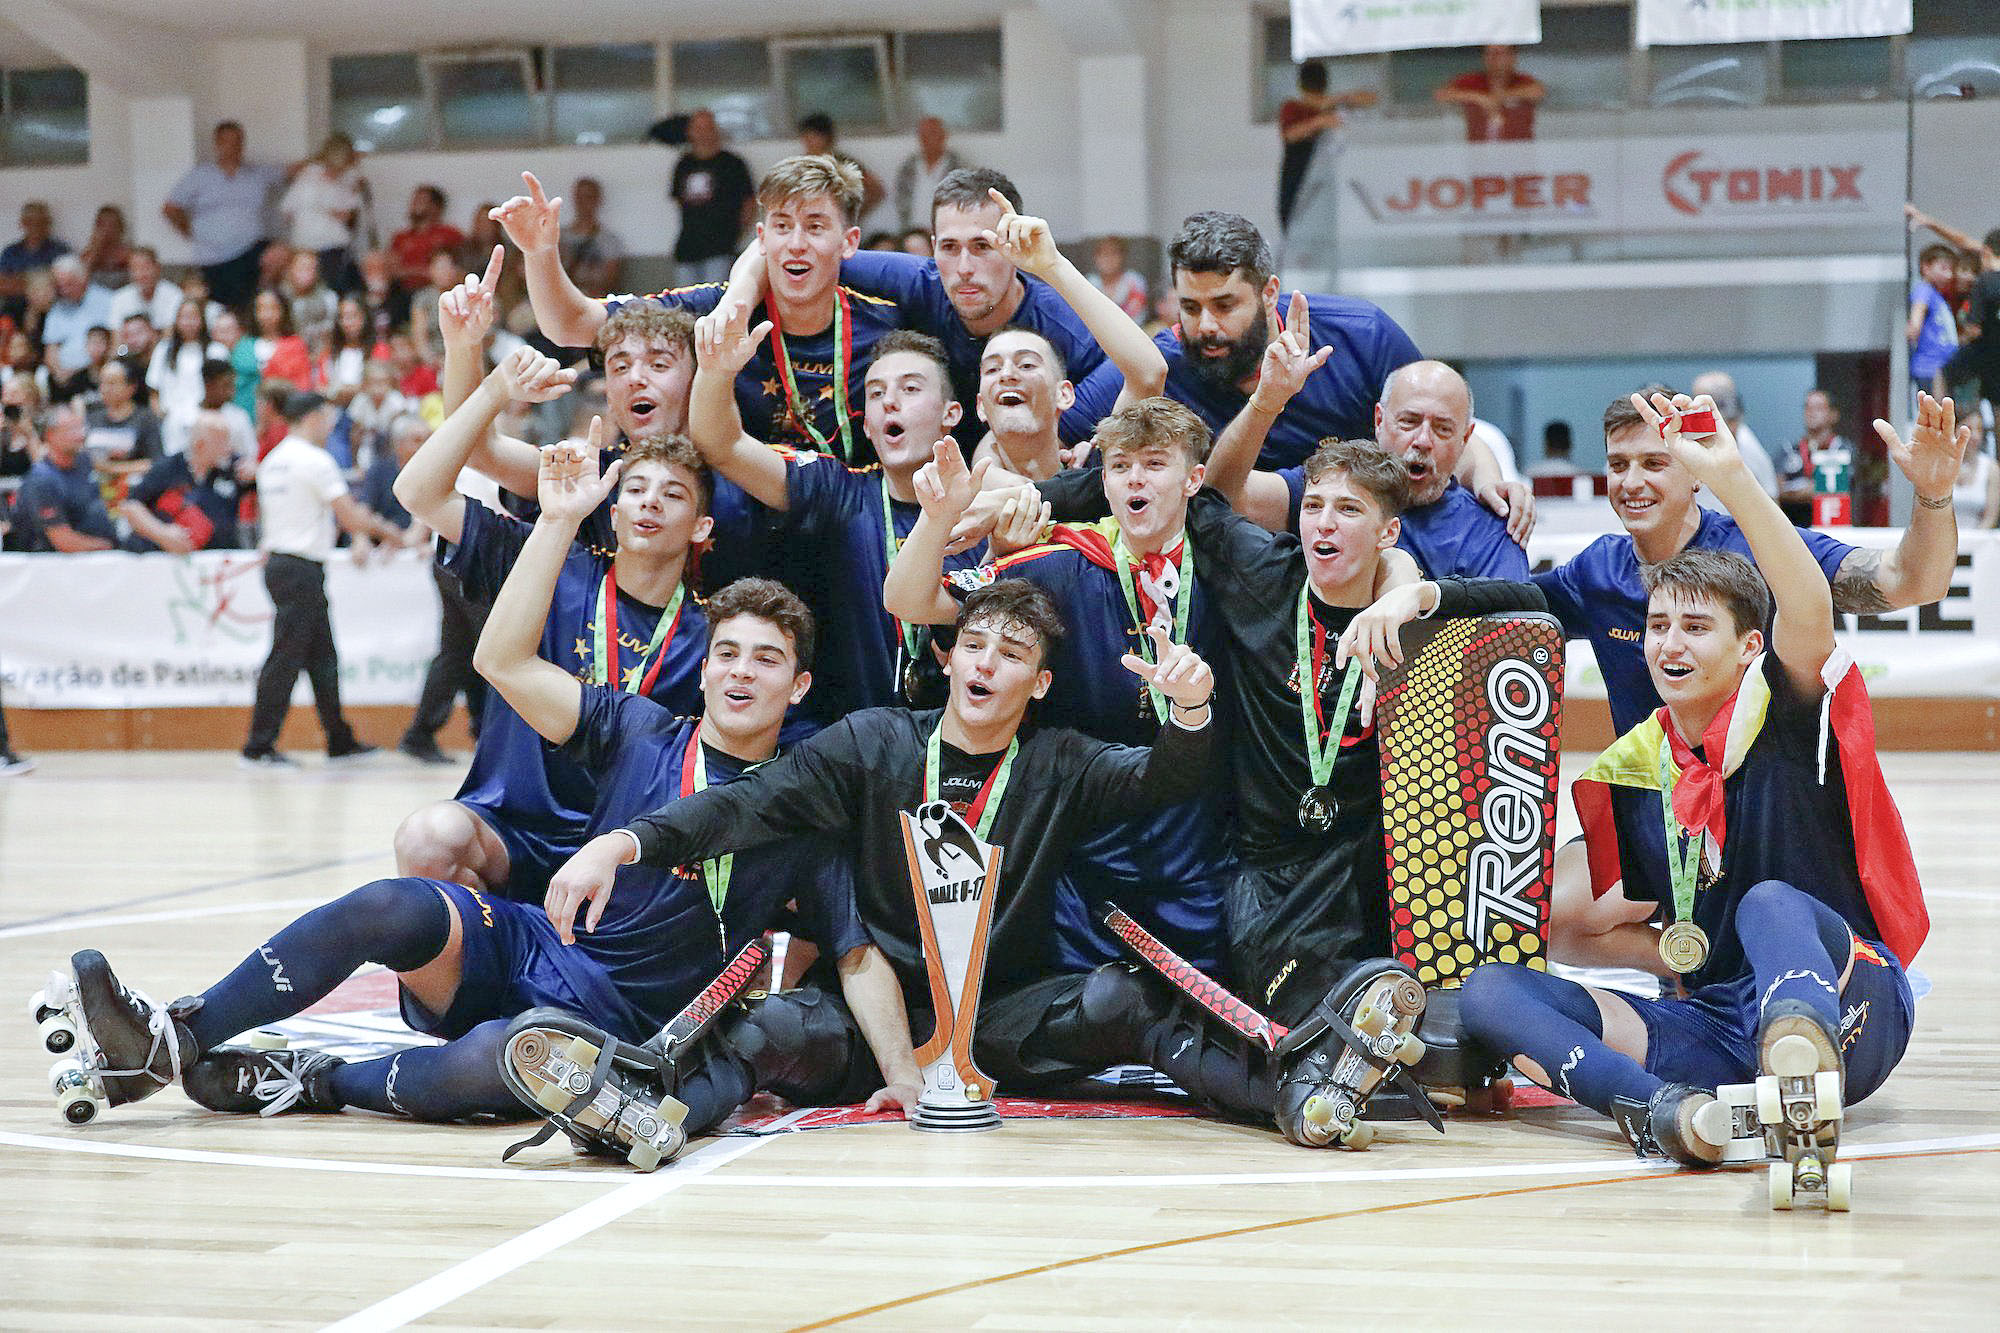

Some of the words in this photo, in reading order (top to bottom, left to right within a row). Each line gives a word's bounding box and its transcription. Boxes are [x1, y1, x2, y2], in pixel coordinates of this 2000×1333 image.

[1386, 173, 1590, 211] JOPER
[1466, 658, 1550, 953] Reno
[928, 882, 959, 905] MALE
